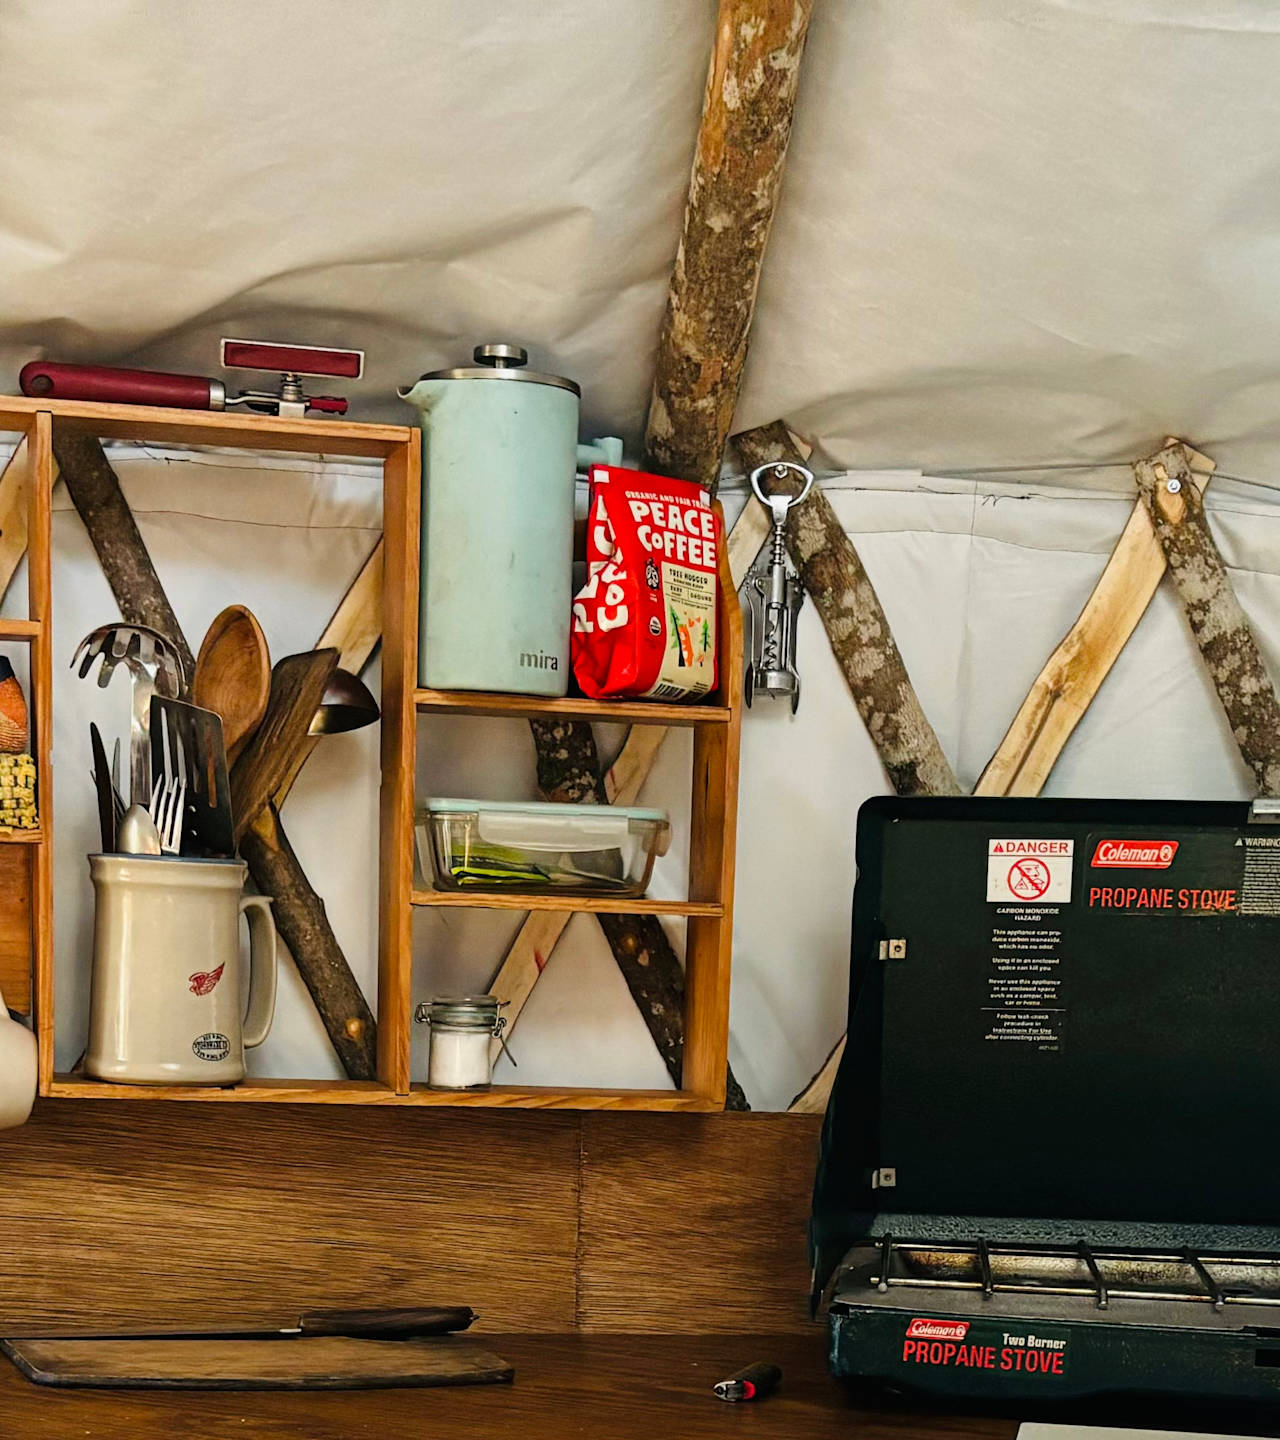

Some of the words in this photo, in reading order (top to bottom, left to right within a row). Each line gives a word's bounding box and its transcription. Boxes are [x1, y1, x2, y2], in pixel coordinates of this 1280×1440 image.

[625, 490, 658, 501] ORGANIC
[660, 494, 674, 503] AND
[676, 496, 691, 505] FAIR
[692, 499, 711, 510] TRA
[628, 500, 715, 539] PEACE
[637, 525, 716, 568] COFFEE
[519, 649, 558, 671] mira
[1006, 842, 1069, 853] DANGER
[1098, 842, 1159, 861] Coleman
[1089, 887, 1174, 908] PROPANE
[1178, 889, 1237, 910] STOVE
[911, 1321, 957, 1337] Coleman
[1003, 1333, 1025, 1347] Two
[1027, 1334, 1066, 1350] Burner
[903, 1340, 996, 1369] PROPANE
[1000, 1348, 1064, 1375] STOVE
